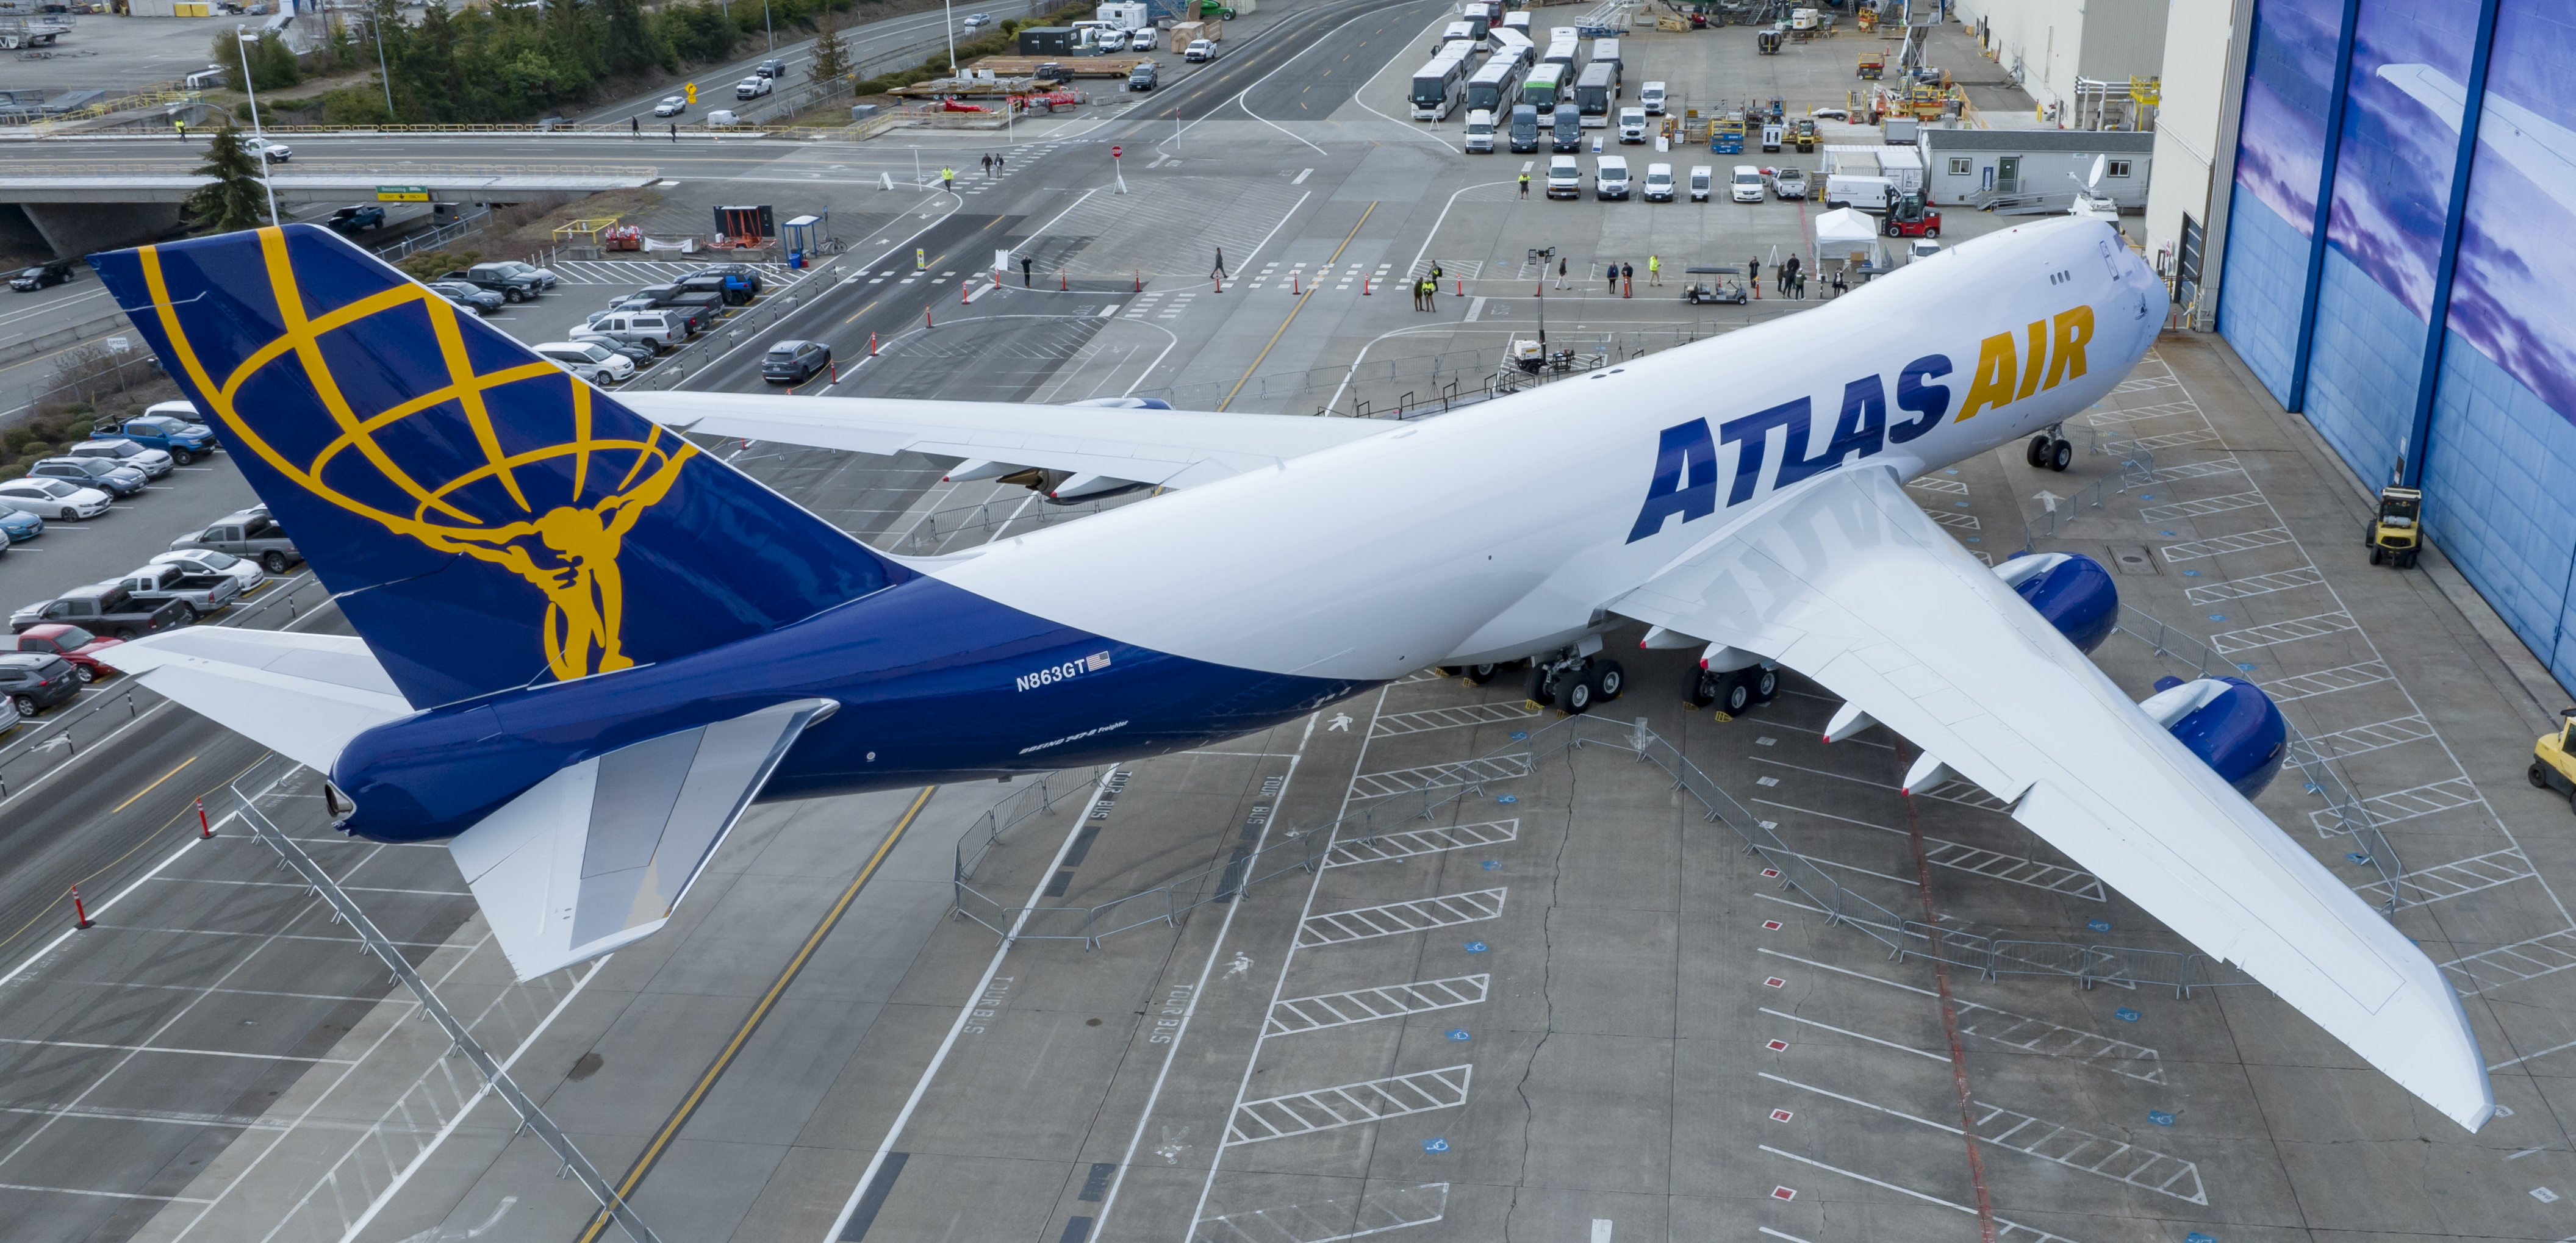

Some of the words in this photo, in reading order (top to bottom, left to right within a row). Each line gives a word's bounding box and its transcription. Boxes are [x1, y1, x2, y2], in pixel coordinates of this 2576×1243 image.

[1625, 354, 1953, 545] ATLAS
[1954, 304, 2095, 424] AIR
[1016, 659, 1085, 692] N863GT
[1019, 739, 1064, 754] BOEING
[1066, 729, 1097, 742] 747-8
[1098, 720, 1128, 733] Freighter
[1104, 772, 1133, 793] TOUR
[1258, 775, 1283, 797] TOUR
[1090, 801, 1115, 819] BUS
[1246, 807, 1269, 824] BUS
[978, 976, 1014, 1007] TOUR
[1161, 984, 1194, 1015] TOUR
[963, 1009, 995, 1034] BUS
[1149, 1019, 1180, 1044] BUS
